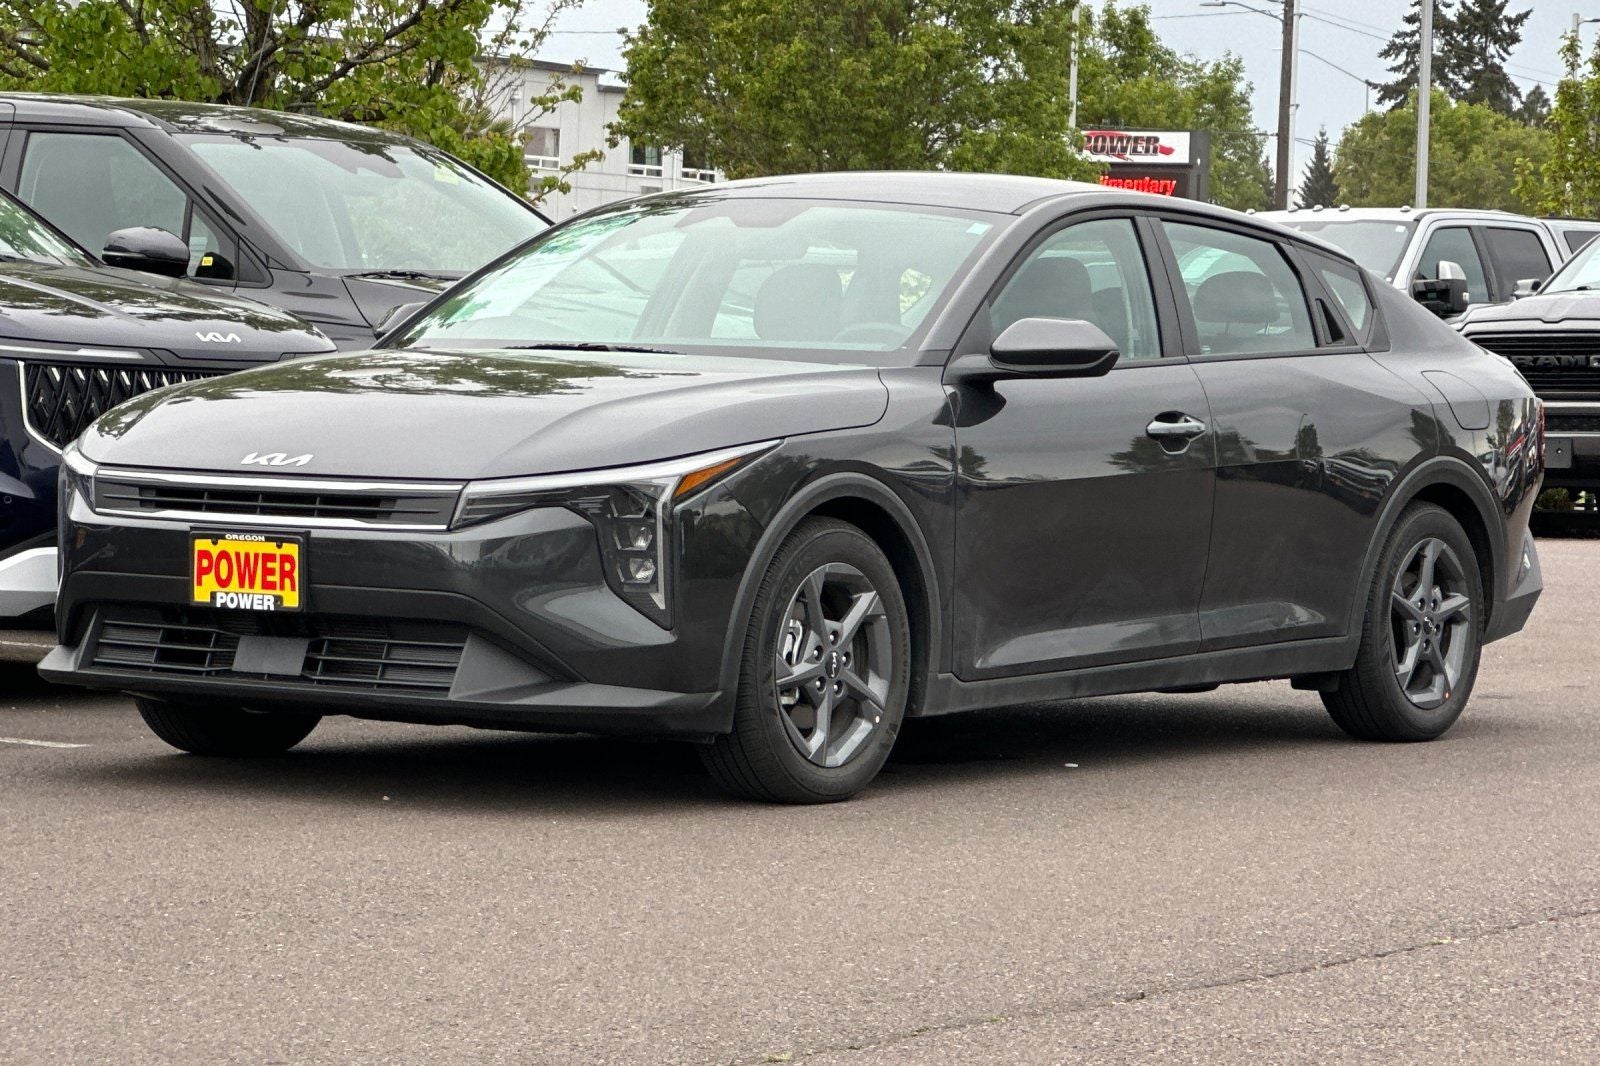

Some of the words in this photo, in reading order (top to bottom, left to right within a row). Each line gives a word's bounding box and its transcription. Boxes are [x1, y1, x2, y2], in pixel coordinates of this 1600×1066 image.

[225, 534, 265, 542] OREGON
[196, 549, 296, 592] POWER
[216, 592, 275, 611] POWER
